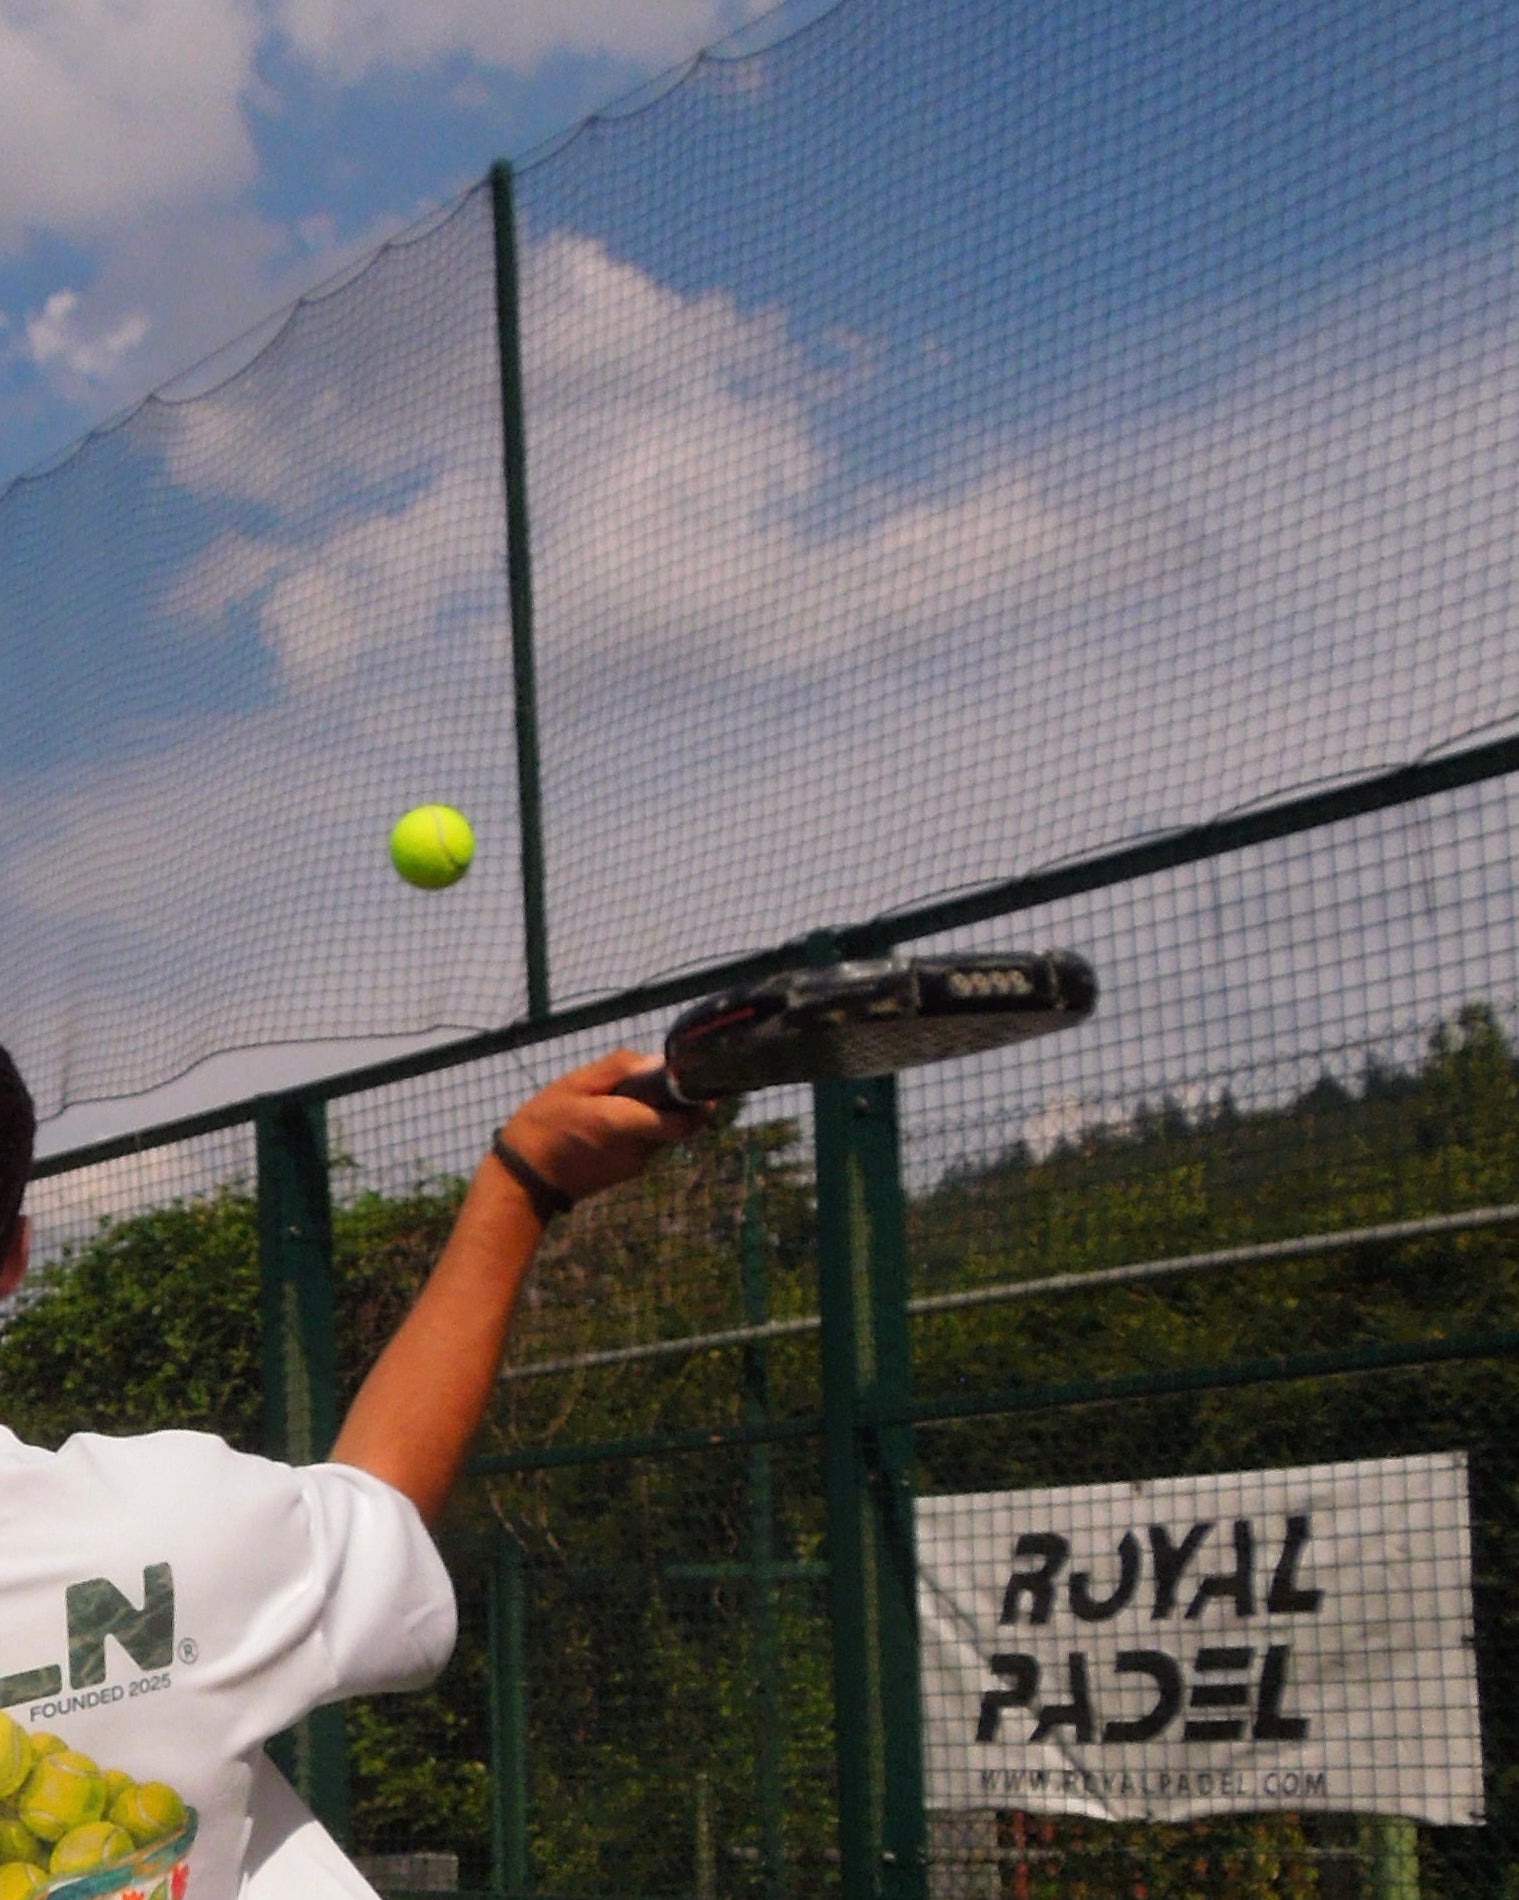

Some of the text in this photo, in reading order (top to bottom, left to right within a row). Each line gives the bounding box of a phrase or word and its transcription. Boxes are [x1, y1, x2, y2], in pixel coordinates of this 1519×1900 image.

[999, 1515, 1325, 1626] ROYAL
[29, 1672, 172, 1723] FOUNDED 2025
[975, 1645, 1310, 1743] PADEL
